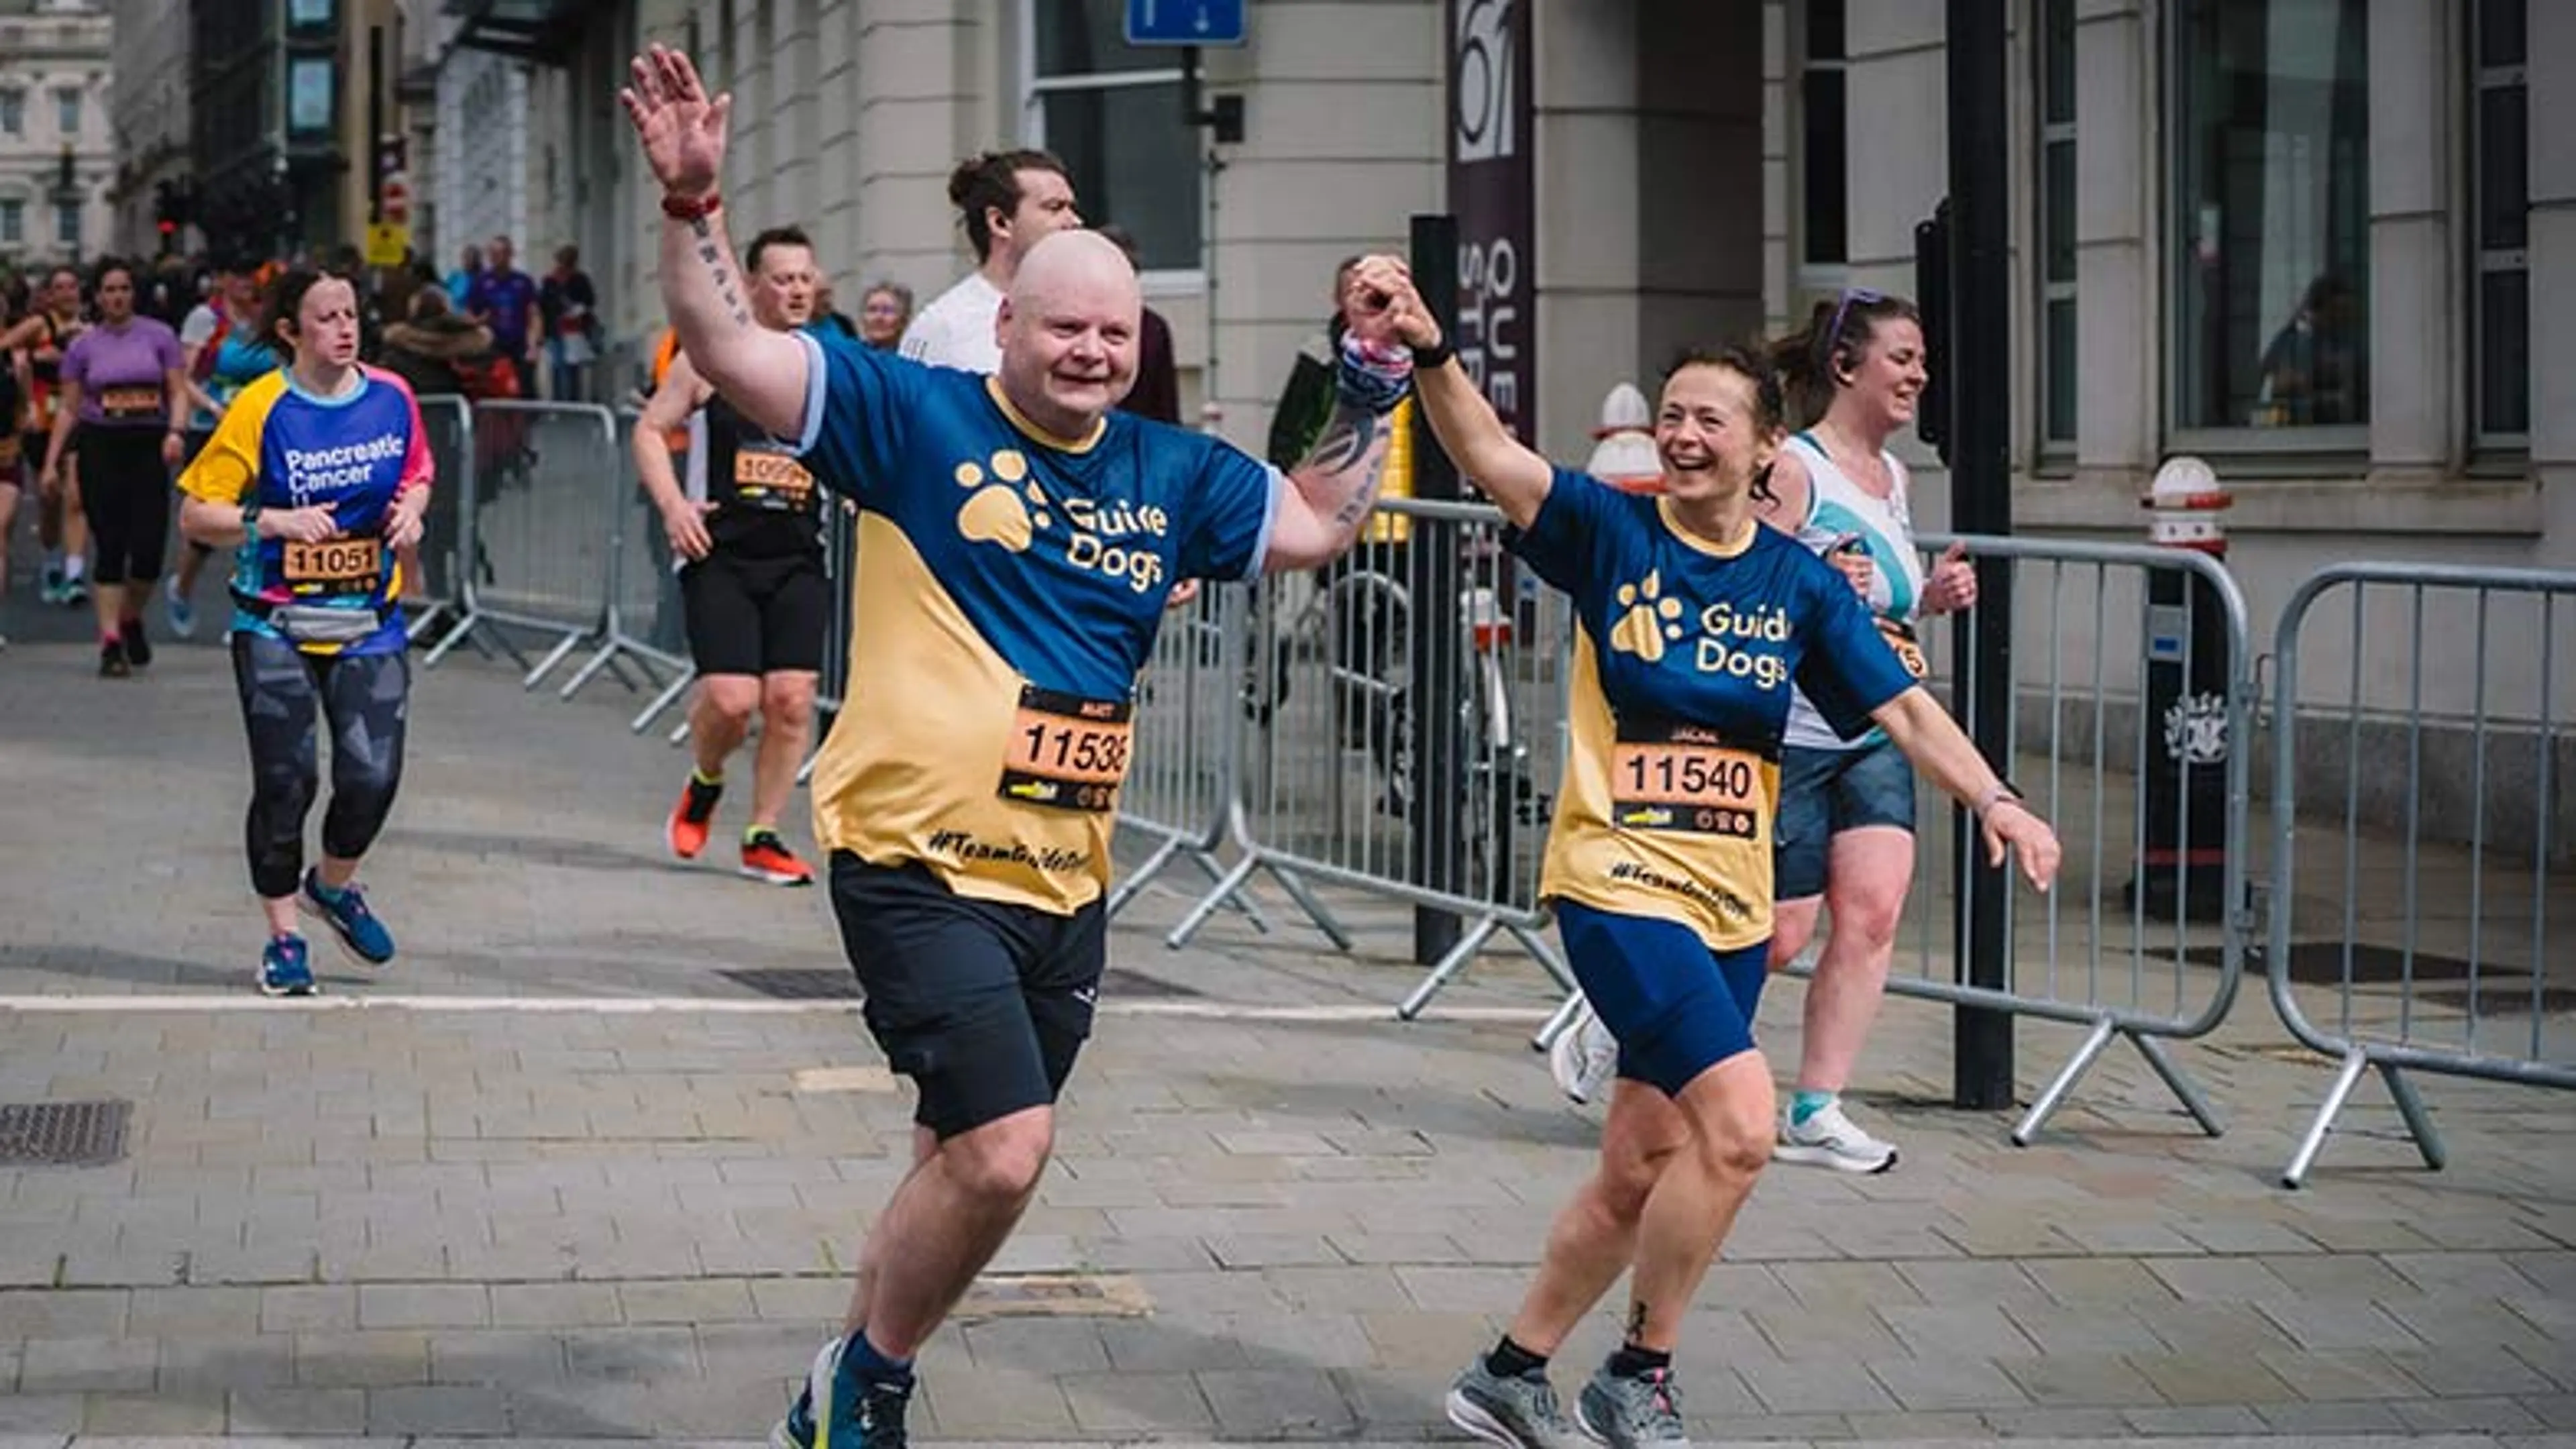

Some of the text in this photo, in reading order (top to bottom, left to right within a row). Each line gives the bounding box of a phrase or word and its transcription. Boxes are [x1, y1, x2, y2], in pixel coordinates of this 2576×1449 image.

[1484, 238, 1517, 436] QUE
[286, 433, 404, 471] Pancreatic
[288, 463, 373, 493] Cancer
[295, 546, 373, 573] 11051
[1067, 532, 1163, 593] Dogs
[1701, 601, 1794, 642] Guid
[1697, 637, 1786, 690] Dogs
[1628, 755, 1752, 799] 11540
